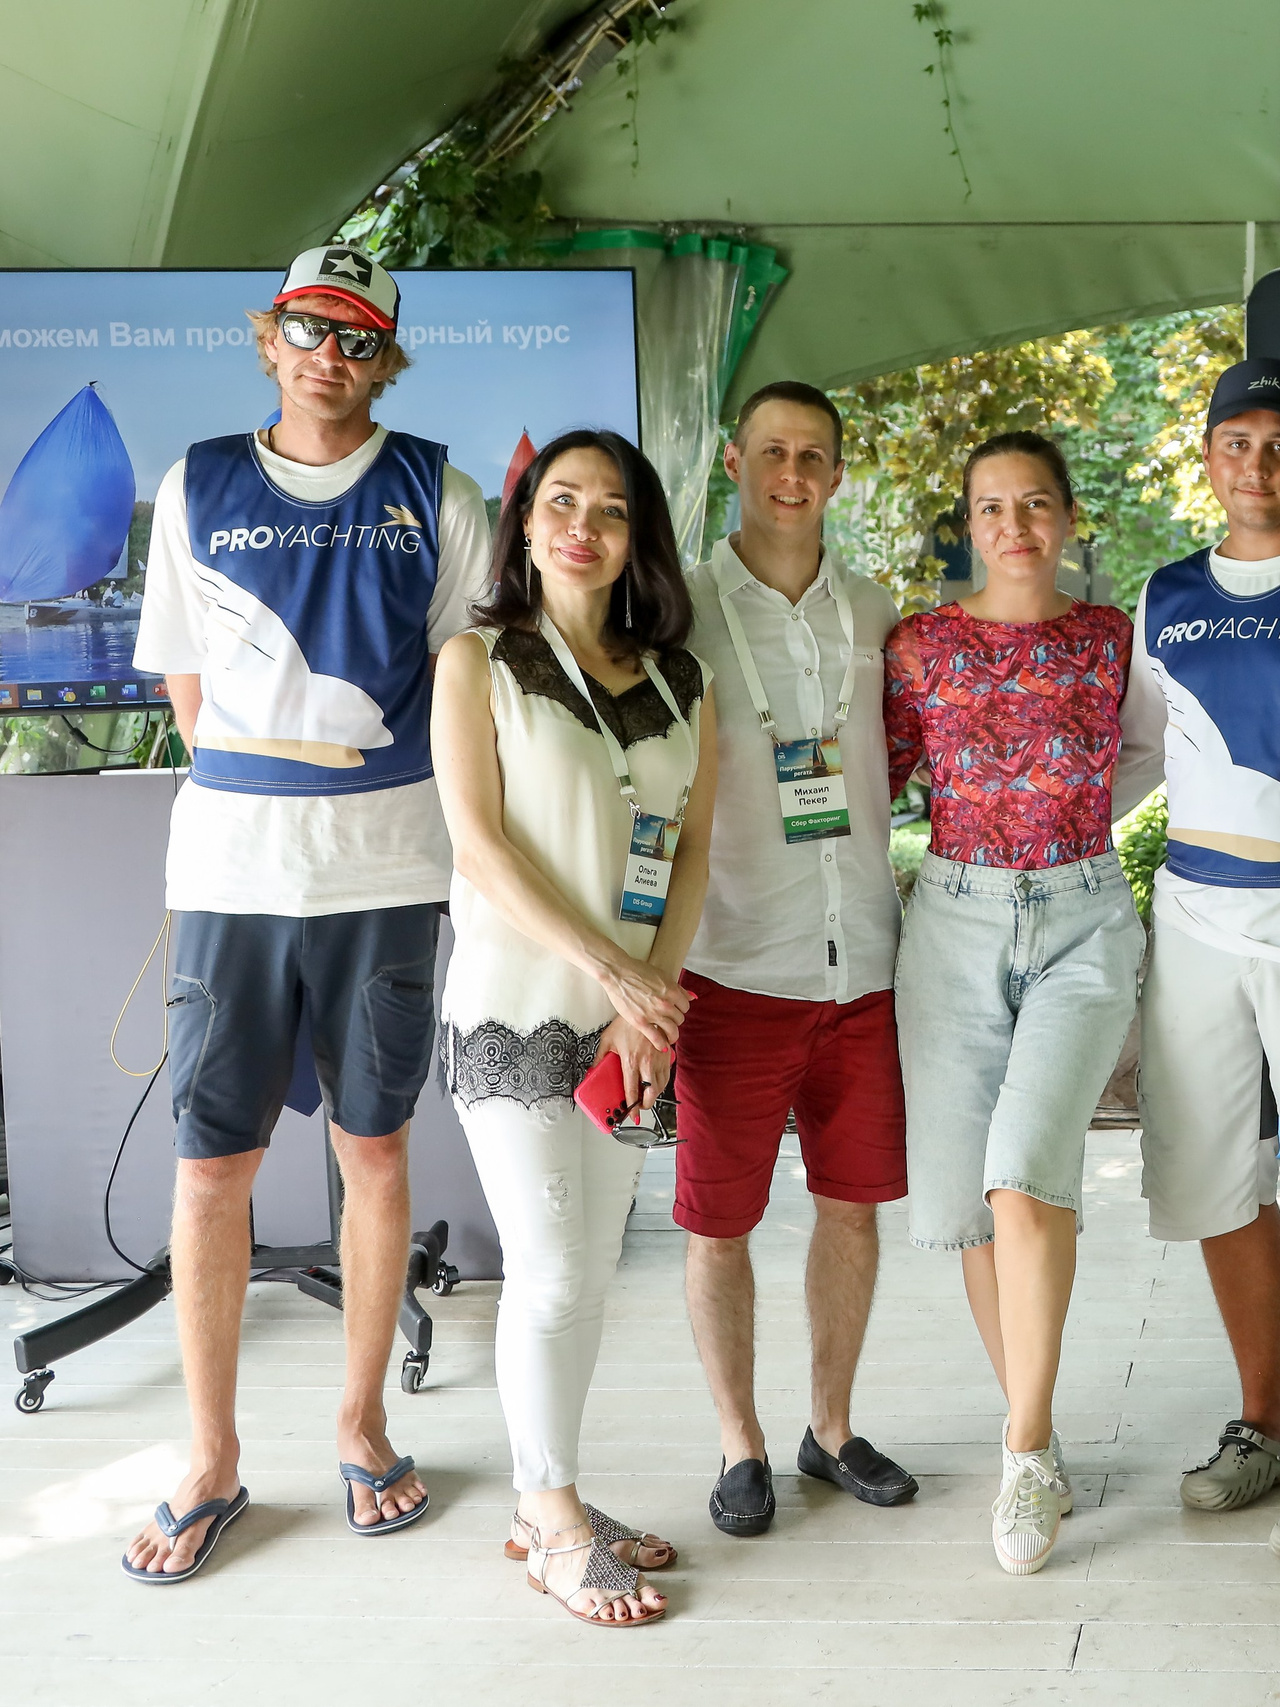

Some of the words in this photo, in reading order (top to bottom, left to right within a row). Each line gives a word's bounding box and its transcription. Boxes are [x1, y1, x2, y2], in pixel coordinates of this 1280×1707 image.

[109, 322, 175, 347] Вам
[503, 324, 570, 350] курс
[1248, 376, 1280, 390] zhik
[209, 524, 421, 555] PROYACHTING
[794, 786, 829, 796] Михаил
[799, 796, 827, 806] Пекер
[808, 816, 840, 824] Факторинг
[639, 865, 657, 876] Ольга
[635, 876, 657, 887] Алиева
